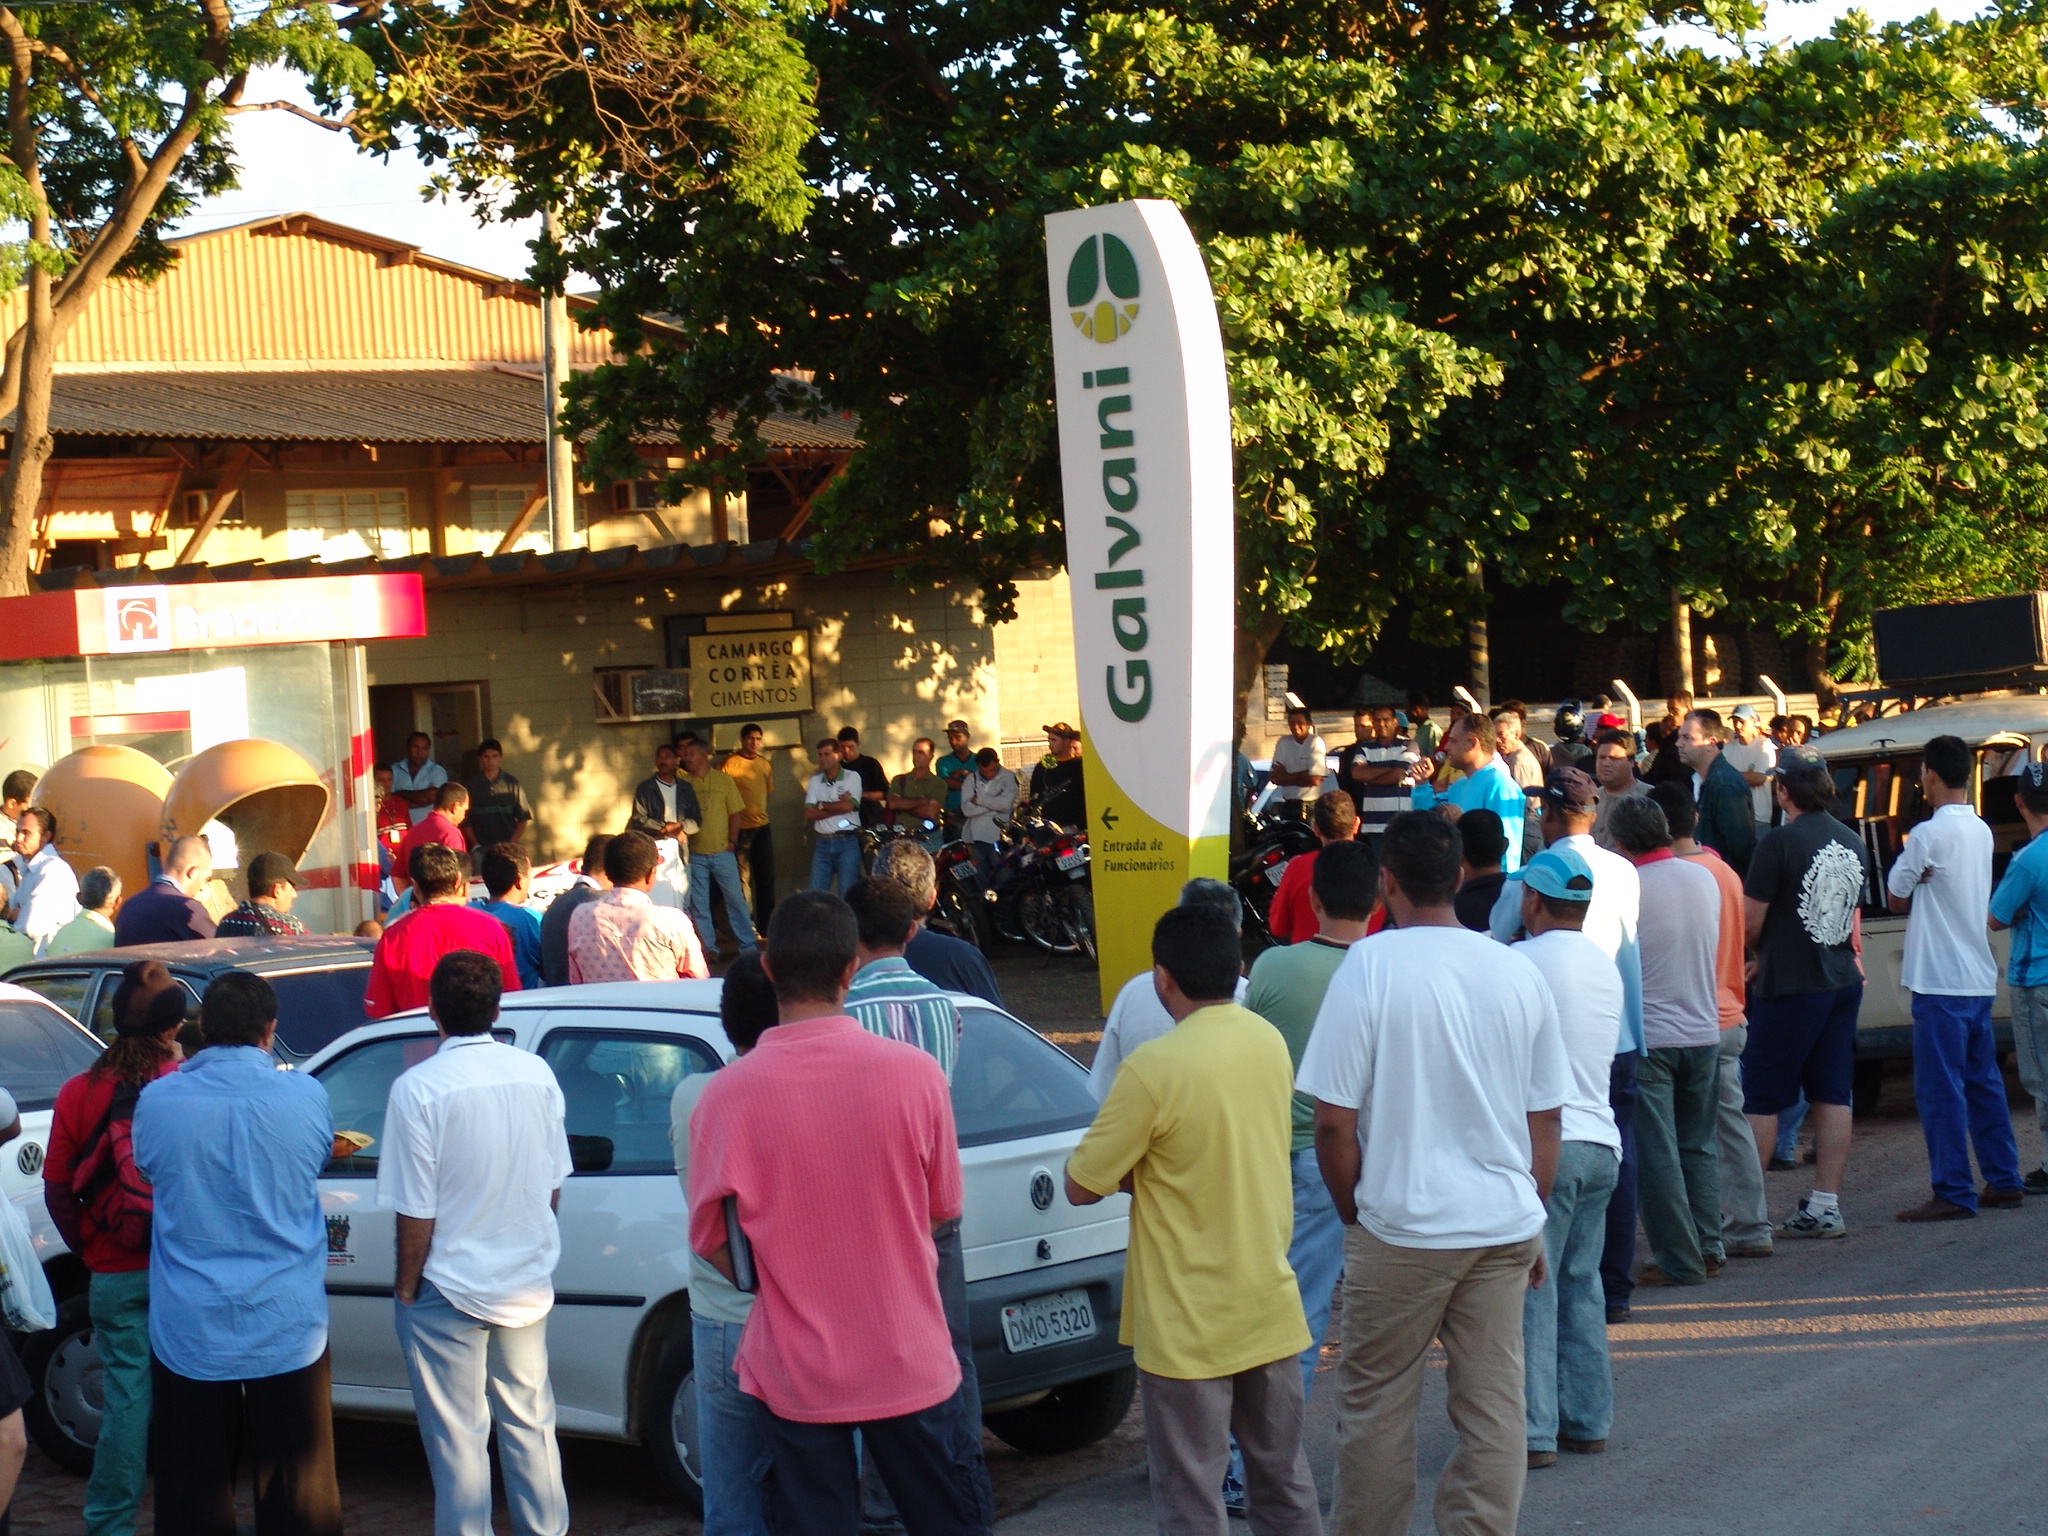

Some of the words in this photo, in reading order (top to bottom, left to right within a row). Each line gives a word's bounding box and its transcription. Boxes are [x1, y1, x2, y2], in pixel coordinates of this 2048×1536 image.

[1082, 365, 1153, 723] Galvani
[174, 602, 336, 641] Bradesco
[707, 639, 793, 660] CAMARGO
[708, 660, 797, 684] CORRÊA
[710, 686, 798, 709] CIMENTOS
[1103, 838, 1146, 852] Entrada
[1150, 837, 1164, 851] de
[1104, 857, 1175, 872] Funcionários
